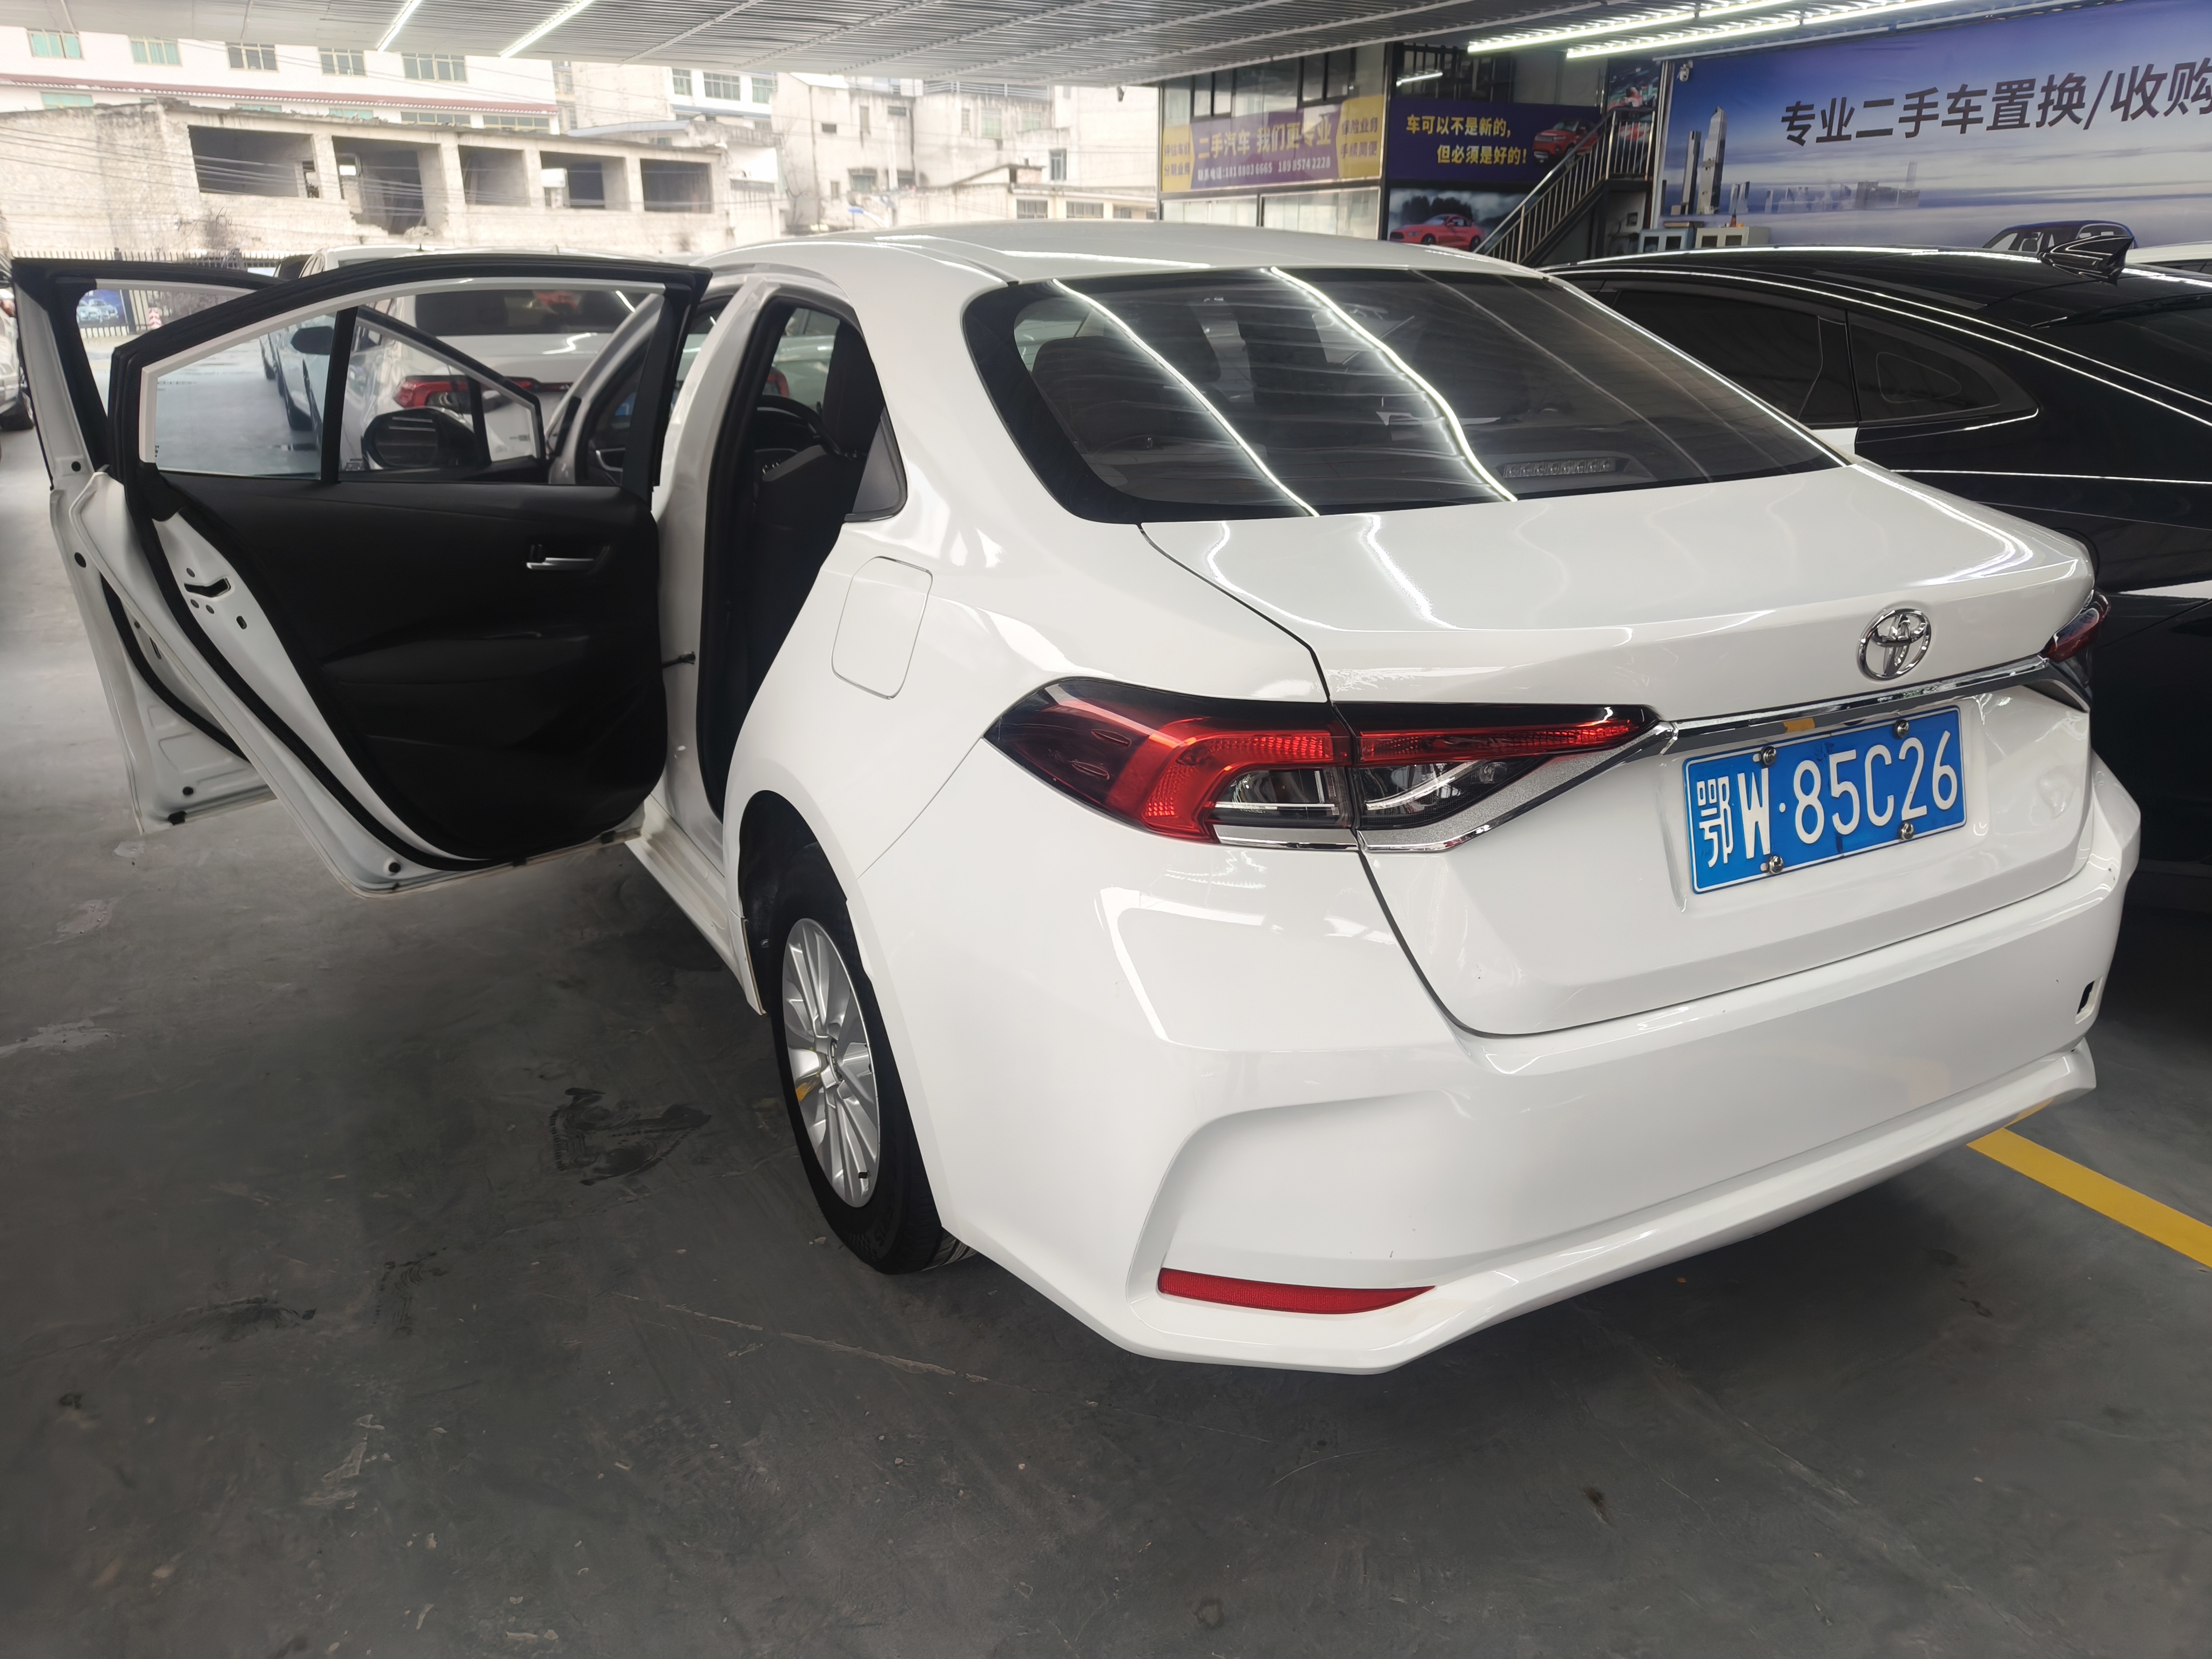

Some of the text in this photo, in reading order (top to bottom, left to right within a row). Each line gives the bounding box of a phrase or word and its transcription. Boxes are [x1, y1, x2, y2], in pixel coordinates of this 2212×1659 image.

[1781, 57, 2212, 147] 专业二手车置换/收购
[1406, 113, 1511, 138] 车可以不是新的，
[1198, 129, 1250, 159] 二手汽车
[1437, 144, 1527, 165] 但必须是好的！
